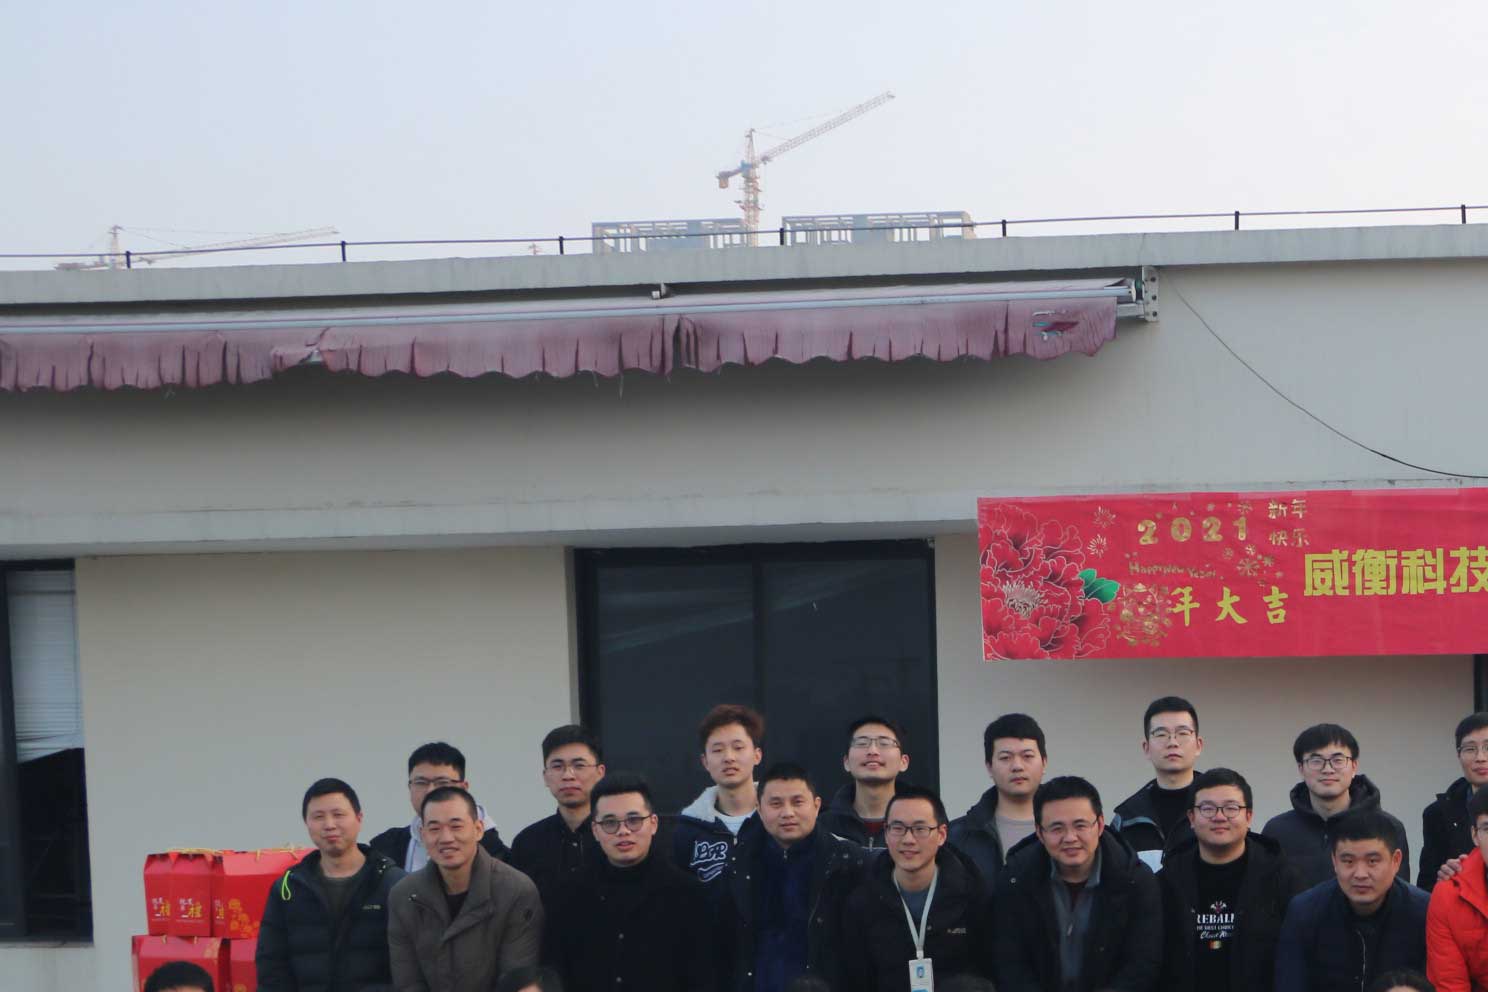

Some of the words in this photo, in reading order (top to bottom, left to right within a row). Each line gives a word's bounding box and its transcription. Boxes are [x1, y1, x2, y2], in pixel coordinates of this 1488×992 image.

[1268, 498, 1307, 520] 新年
[1137, 516, 1247, 545] 2021
[1269, 528, 1309, 547] 快乐
[1168, 585, 1288, 626] 年大吉
